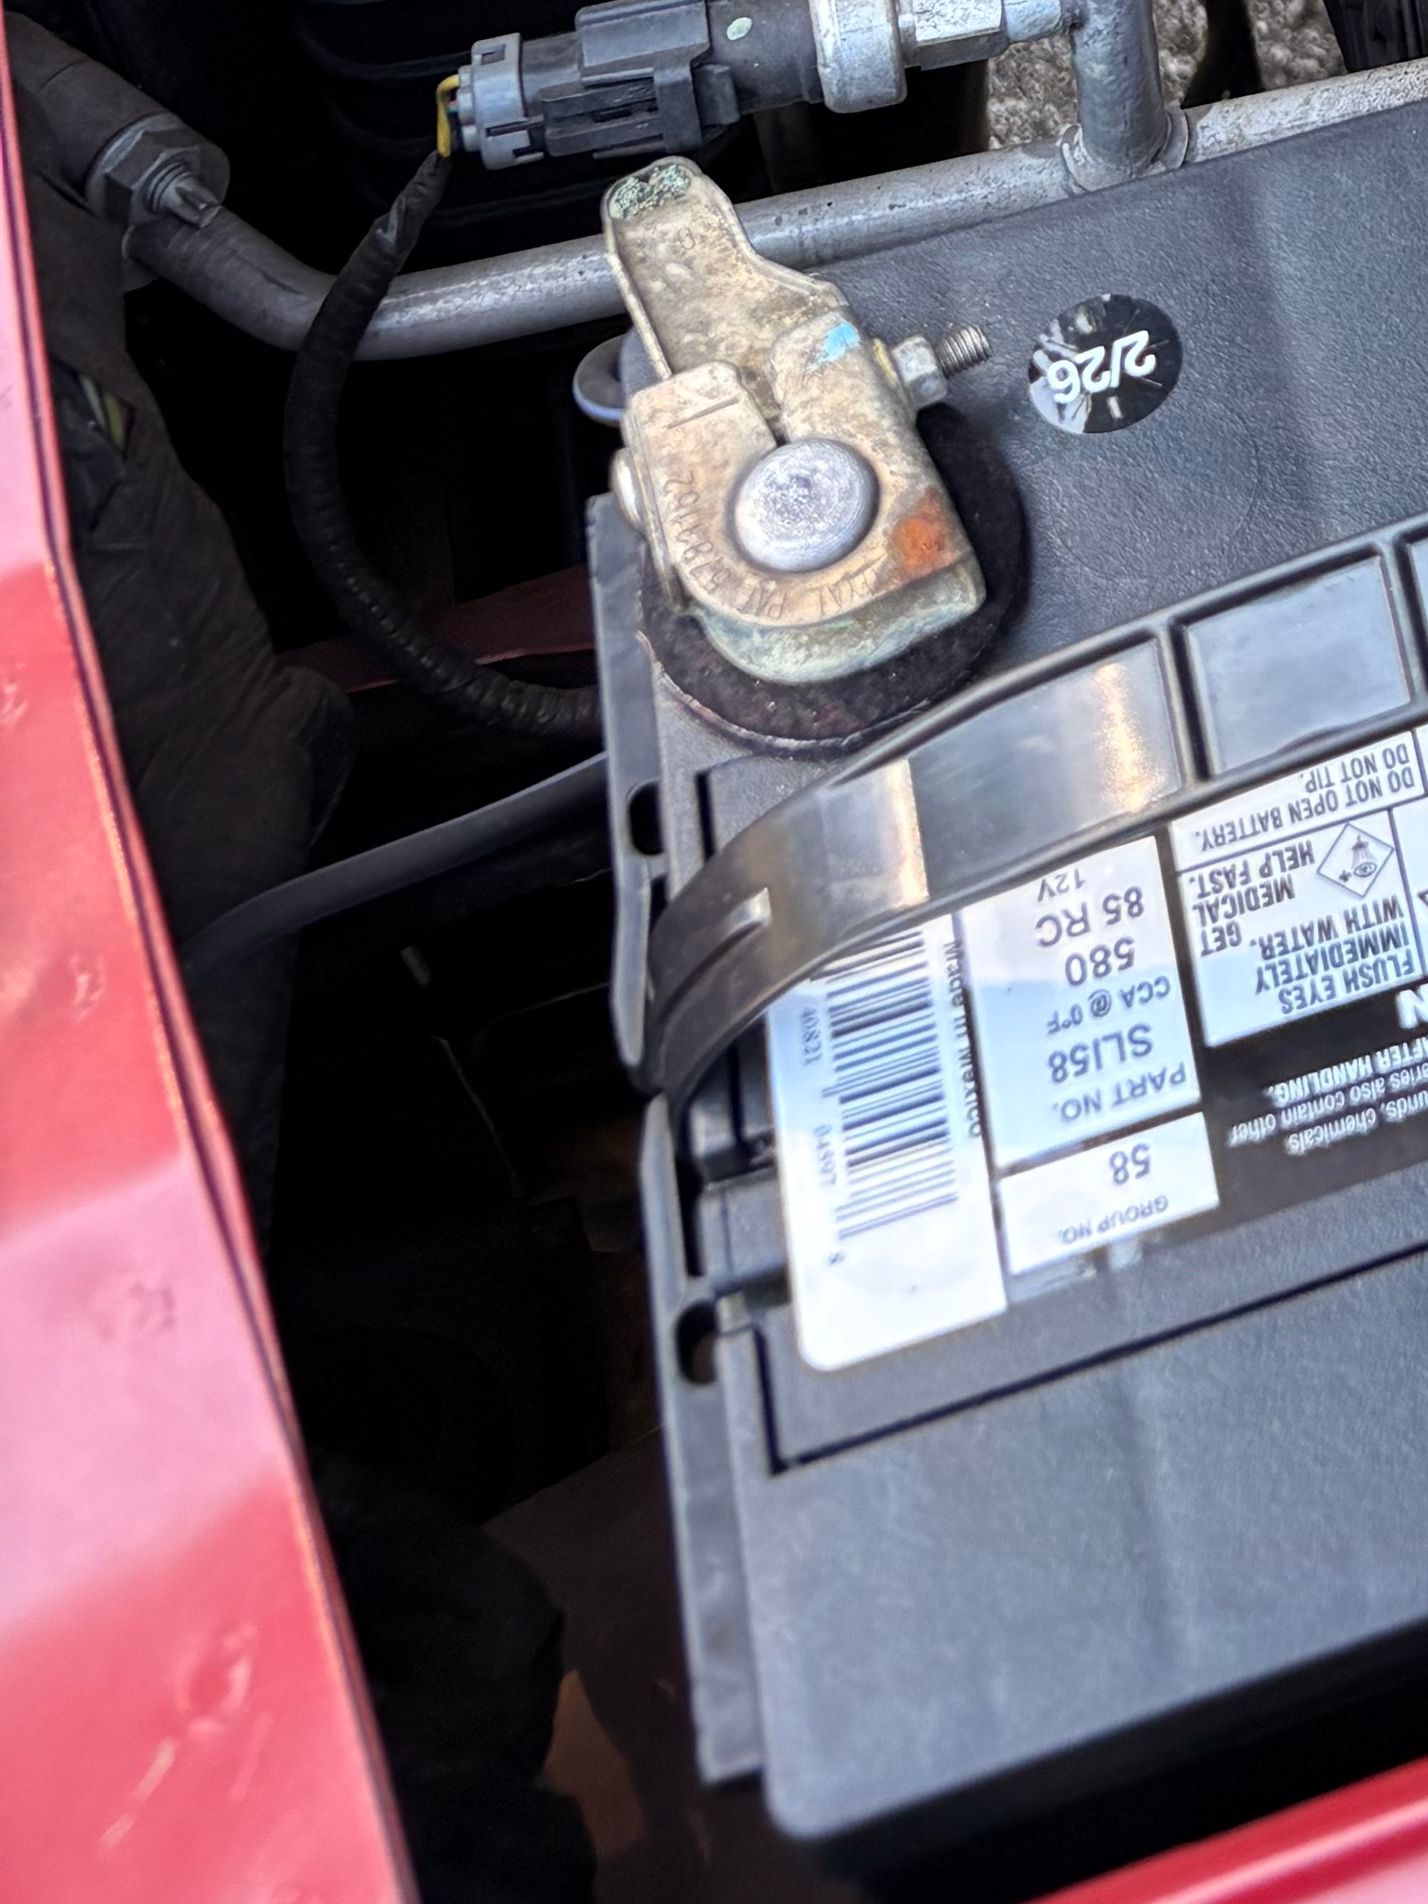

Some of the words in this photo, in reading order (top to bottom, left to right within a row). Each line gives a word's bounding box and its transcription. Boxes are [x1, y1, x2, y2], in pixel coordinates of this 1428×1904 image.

[1047, 330, 1157, 404] 2/26
[1336, 750, 1378, 784] NOT
[1380, 740, 1410, 770] DO
[1298, 764, 1333, 796] TIP.
[1341, 774, 1382, 808] NOT
[1384, 763, 1415, 794] DO
[1286, 786, 1339, 826] OPEN
[1193, 803, 1283, 856] BATTERY.
[1187, 857, 1252, 902] FAST.
[1255, 838, 1314, 880] HELP
[1033, 865, 1086, 902] 12V
[1100, 883, 1145, 927] 85
[1190, 872, 1295, 930] MEDICAL
[1033, 901, 1091, 949] RC
[1338, 891, 1403, 935] WITH
[1196, 917, 1243, 958] GET
[1248, 912, 1336, 964] WATER.
[1250, 918, 1409, 995] IMMEDIATELY
[1062, 934, 1137, 989] 580
[1340, 946, 1415, 995] FLUSH
[1086, 985, 1114, 1020] @
[1118, 972, 1172, 1011] CCA
[1276, 972, 1337, 1016] EYES
[1044, 1019, 1154, 1087] SLI58
[1109, 1059, 1187, 1106] PART
[1262, 1051, 1373, 1109] HANDLING.
[1050, 1088, 1102, 1126] NO.
[1283, 1105, 1378, 1156] chemicals
[1107, 1140, 1154, 1187] 58
[1056, 1218, 1092, 1246] NO.
[1095, 1192, 1169, 1233] GROUP
